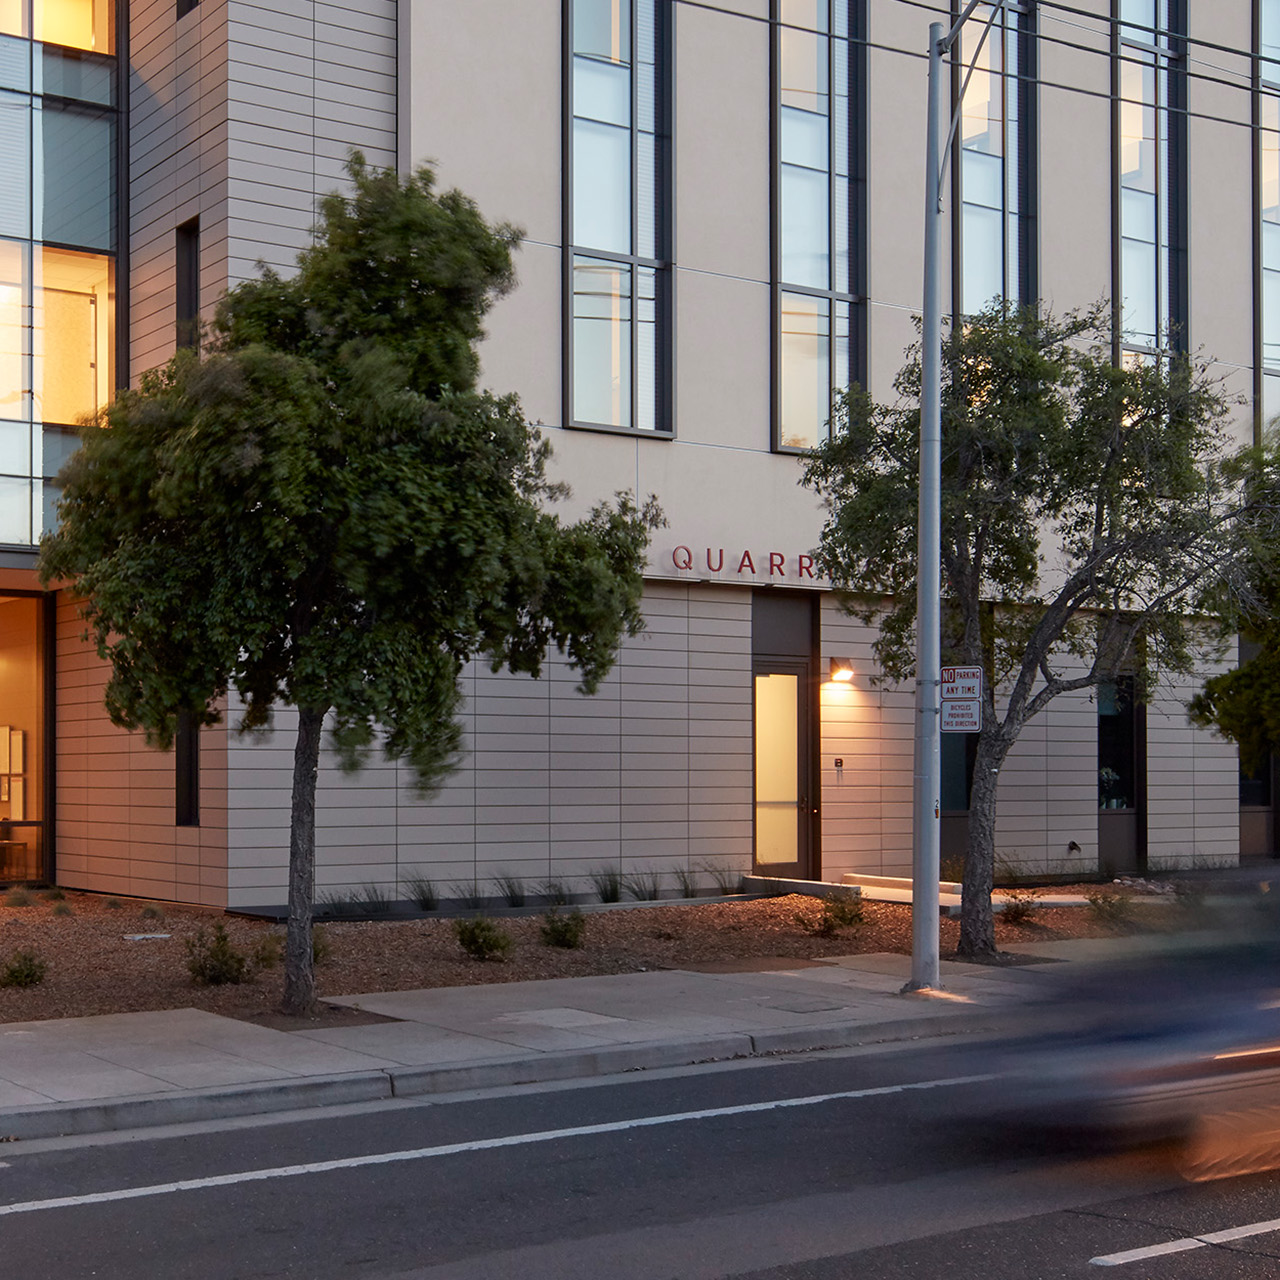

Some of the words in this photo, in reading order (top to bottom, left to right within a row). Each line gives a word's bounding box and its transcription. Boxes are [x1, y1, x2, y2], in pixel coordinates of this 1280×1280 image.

[942, 669, 954, 682] NO
[956, 671, 980, 680] PARKING
[946, 686, 959, 695] ANY
[961, 686, 976, 695] TIME
